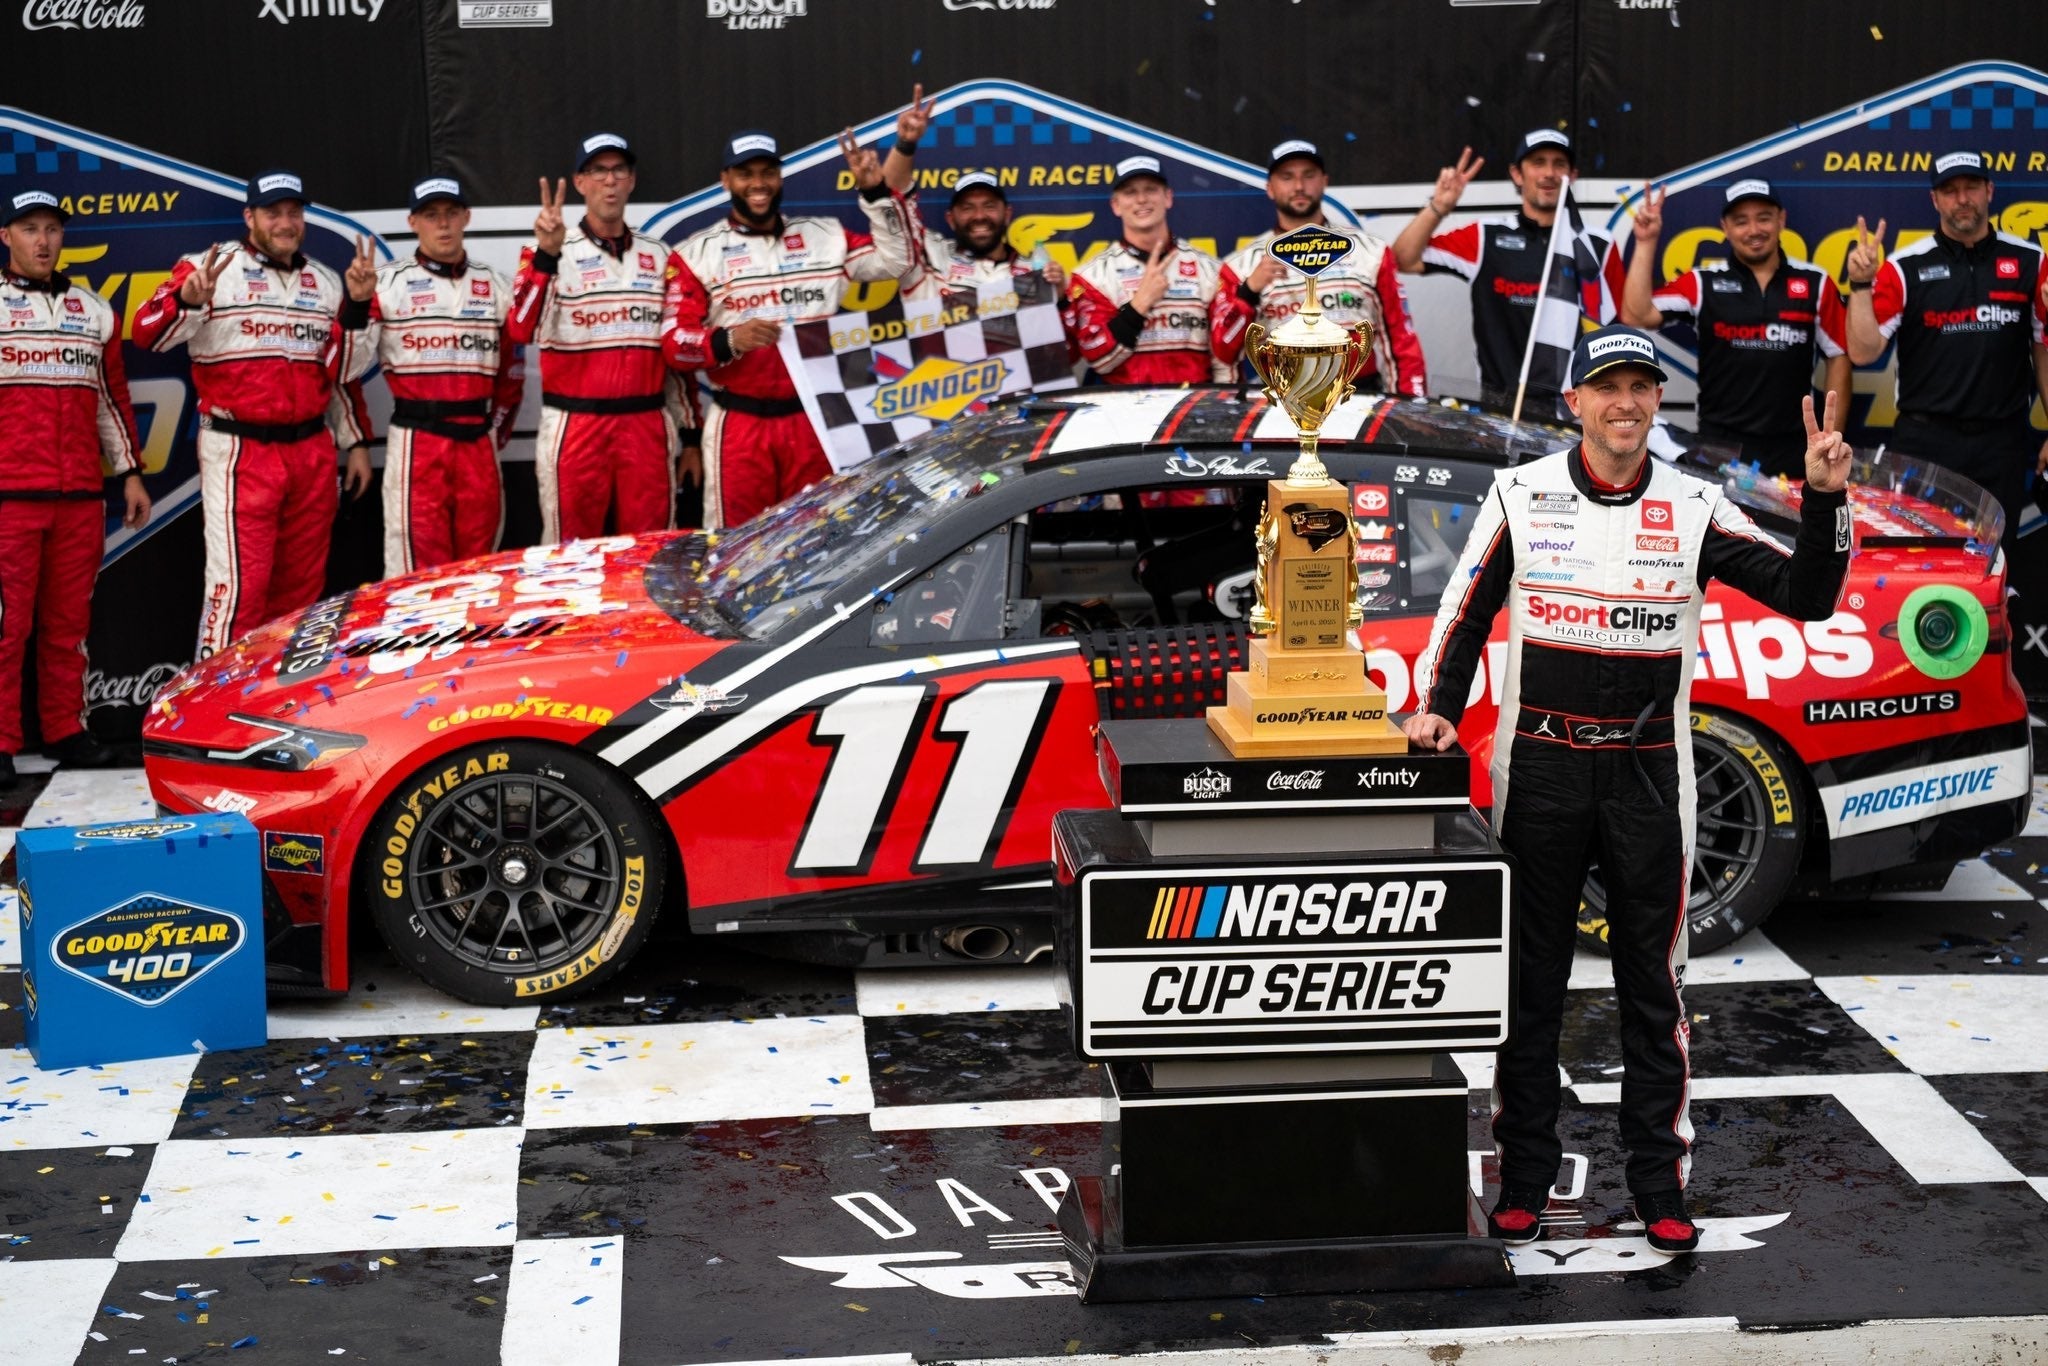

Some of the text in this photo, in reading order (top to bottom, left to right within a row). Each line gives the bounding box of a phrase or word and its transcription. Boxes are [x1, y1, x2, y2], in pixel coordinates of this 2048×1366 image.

[472, 6, 539, 18] CUP SERIES
[728, 15, 785, 30] LIGHT
[1823, 151, 2016, 172] DARLINON
[1029, 164, 1116, 186] RACEW
[60, 191, 180, 216] ACEWAY
[1275, 239, 1348, 253] GOODYEAR
[1293, 253, 1331, 266] 400
[723, 287, 825, 312] SportClips
[572, 306, 662, 330] SportClip
[830, 291, 1020, 350] GOODYEAR 400
[1143, 313, 1208, 331] ortClips
[1923, 304, 2021, 328] SportClips
[1713, 322, 1808, 345] SportClips
[1942, 322, 2001, 333] HAIRCUTS
[1592, 337, 1652, 354] GOODYEAR
[1732, 339, 1787, 351] HAIRCUTS
[881, 367, 1000, 416] SUNOCO
[1545, 493, 1574, 502] NASCAR
[1549, 503, 1572, 511] SERIES
[1530, 521, 1575, 531] SportClips
[1356, 544, 1394, 562] oca-Cola
[1529, 539, 1575, 552] yahoo!
[1637, 535, 1678, 551] Coca-Cola
[1563, 557, 1596, 567] NATIONAL
[1628, 558, 1685, 569] GOODYEAR
[1527, 571, 1575, 582] PROGRESSIVE
[1288, 599, 1341, 613] WINNER
[1528, 596, 1678, 637] SportClips
[1555, 625, 1642, 644] HAIRCUTS
[427, 696, 614, 733] GOODYEAR
[1256, 707, 1384, 725] GOODYEAR 400
[1808, 692, 1956, 722] HAIRCUTS
[788, 678, 1058, 873] 11
[1183, 776, 1232, 795] BUSCH
[1266, 769, 1326, 790] Coca-Cola
[1357, 767, 1421, 789] xfinity
[1750, 752, 1790, 816] YEARS
[203, 790, 258, 815] JGR
[1193, 791, 1222, 799] LIGHT
[1839, 765, 2000, 822] PROGRESSIVE
[382, 752, 510, 899] GOODYEAR
[270, 845, 320, 862] SUNOCO
[624, 866, 642, 908] 100
[106, 908, 192, 922] DARLINGTON RACEWAY
[1219, 880, 1448, 938] NASCAR
[66, 922, 229, 955] GOODYEAR
[107, 952, 192, 983] 400
[525, 955, 599, 995] YEARS
[1142, 959, 1452, 1016] CUP SERIES
